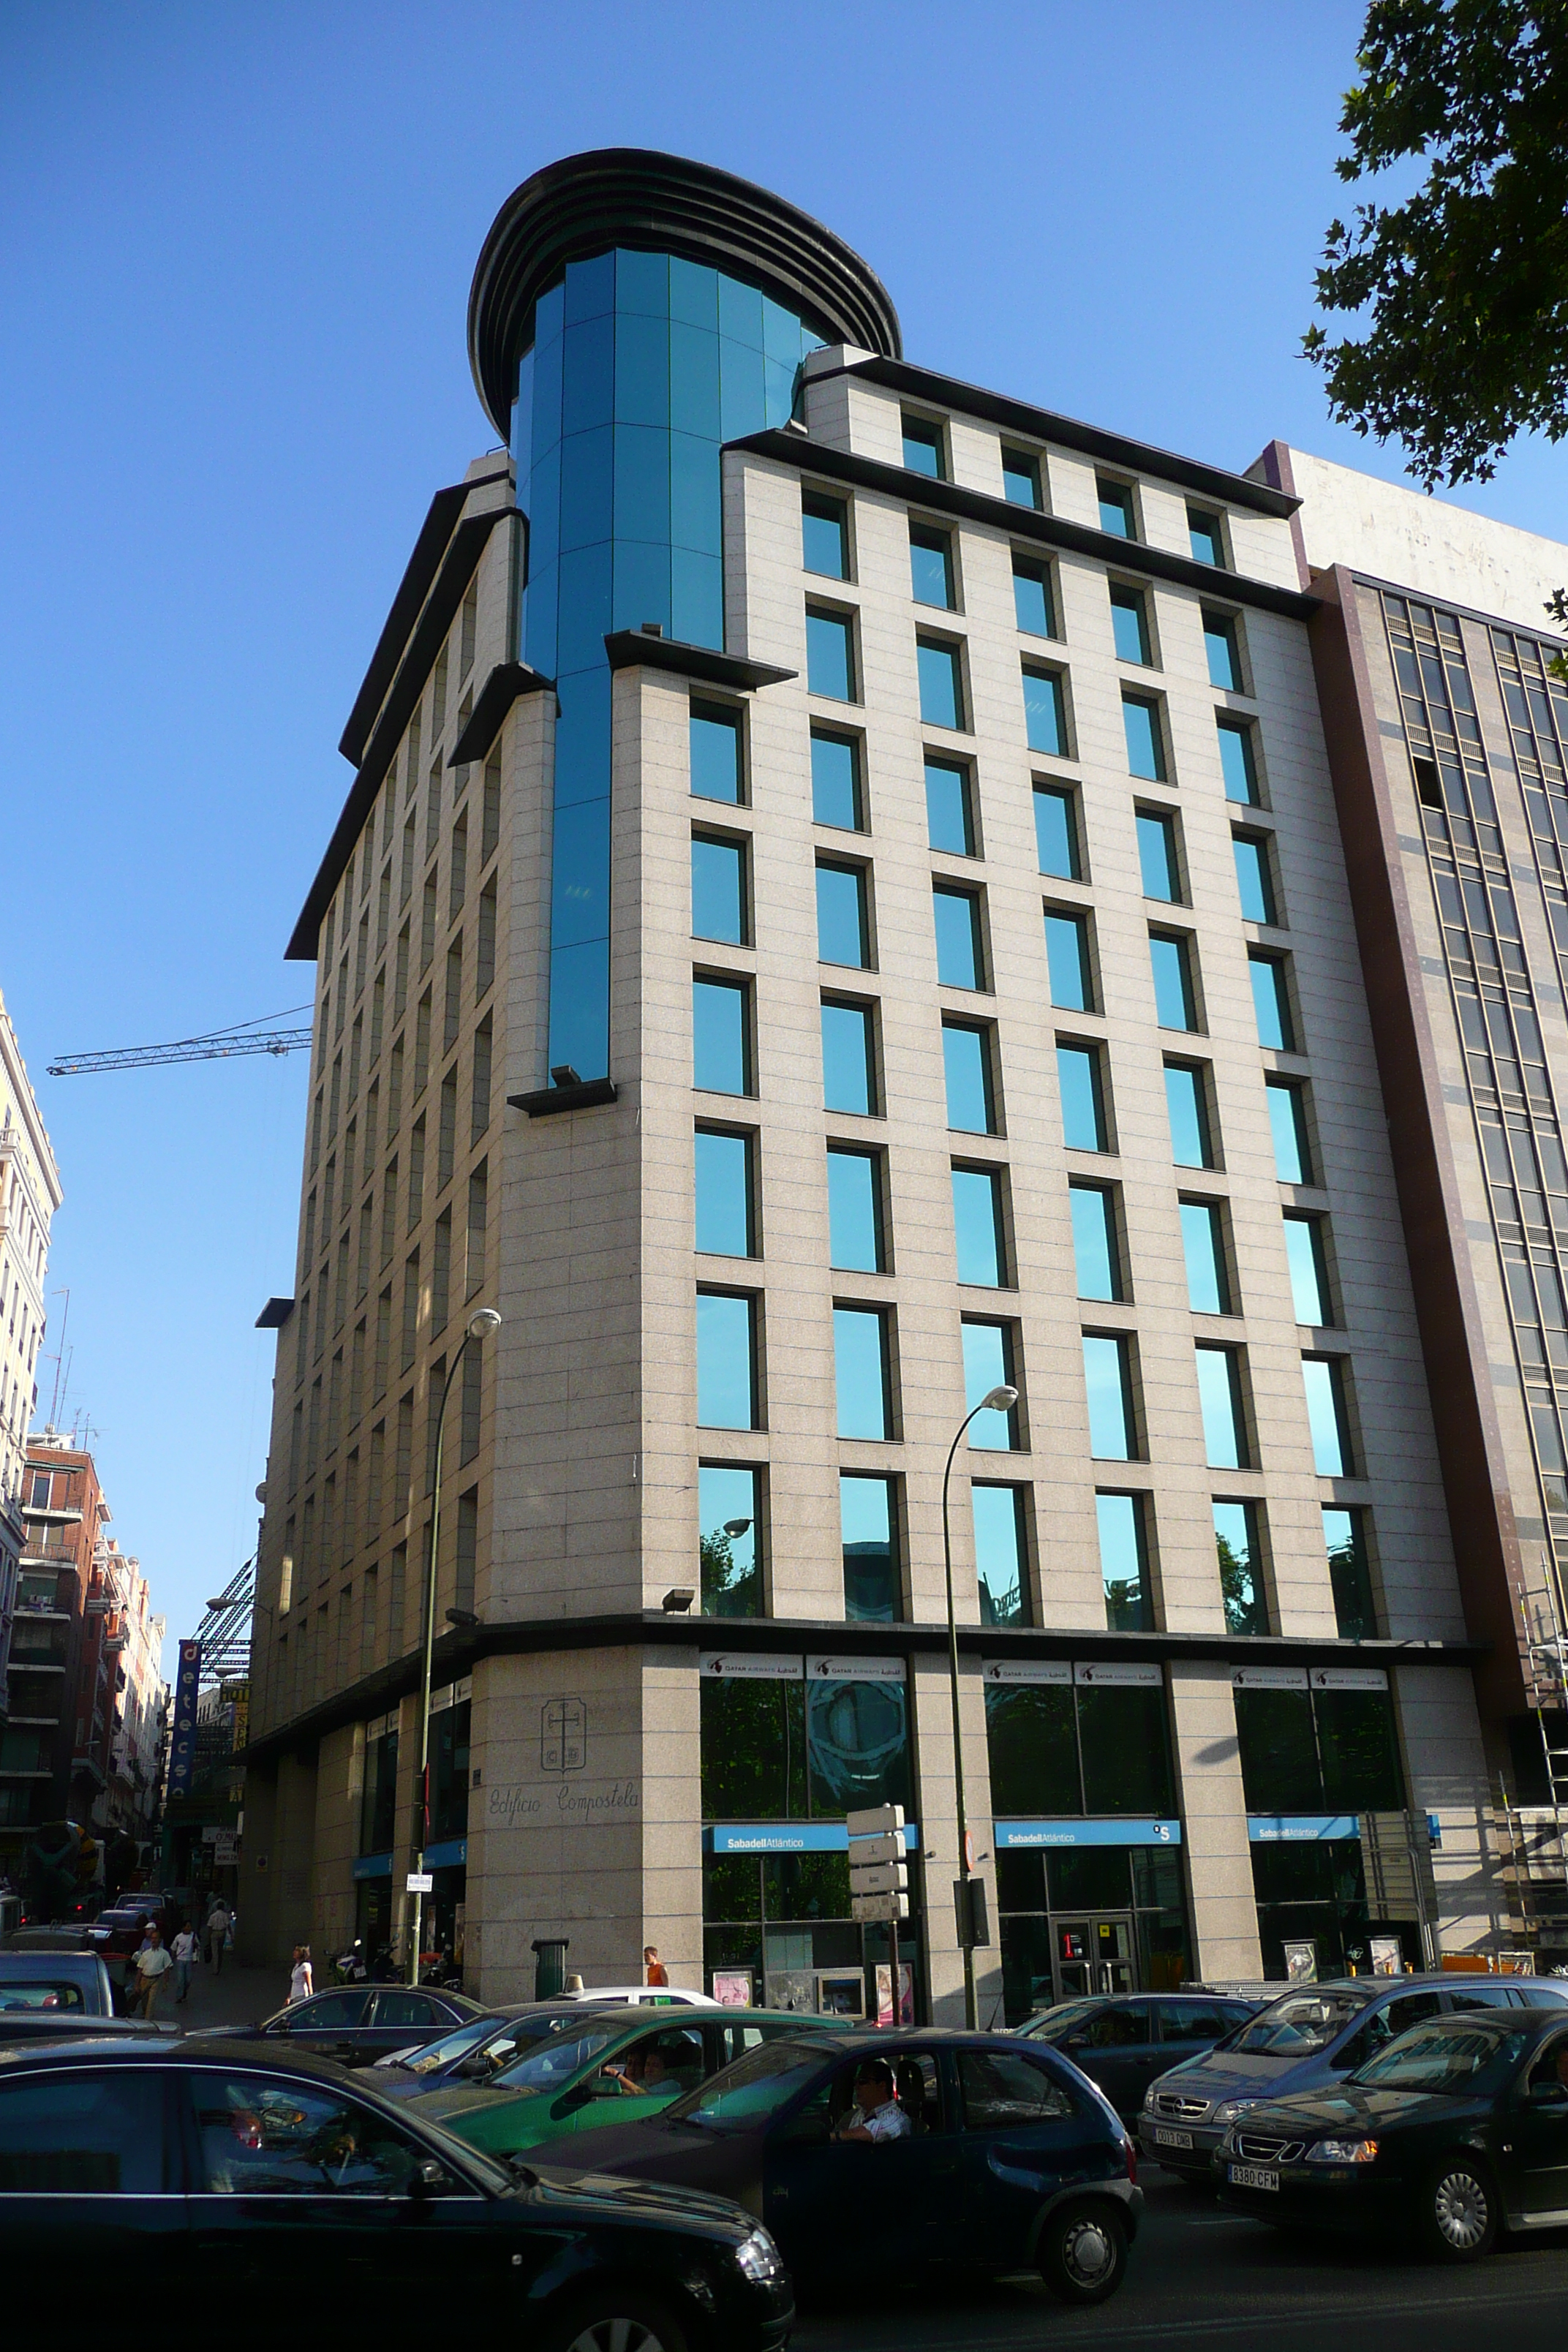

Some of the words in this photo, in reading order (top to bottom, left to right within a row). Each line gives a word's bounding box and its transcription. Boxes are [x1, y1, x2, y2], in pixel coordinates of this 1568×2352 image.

[489, 1789, 540, 1825] Edificio
[557, 1782, 638, 1820] Compostela
[1008, 1833, 1075, 1844] SabadellAtlántico
[1259, 1828, 1319, 1837] SabadellAtlántico
[728, 1838, 804, 1849] SabadellAtlántico
[1158, 2130, 1175, 2144] 0013
[1233, 2167, 1255, 2185] 8380
[1257, 2172, 1278, 2188] CFM
